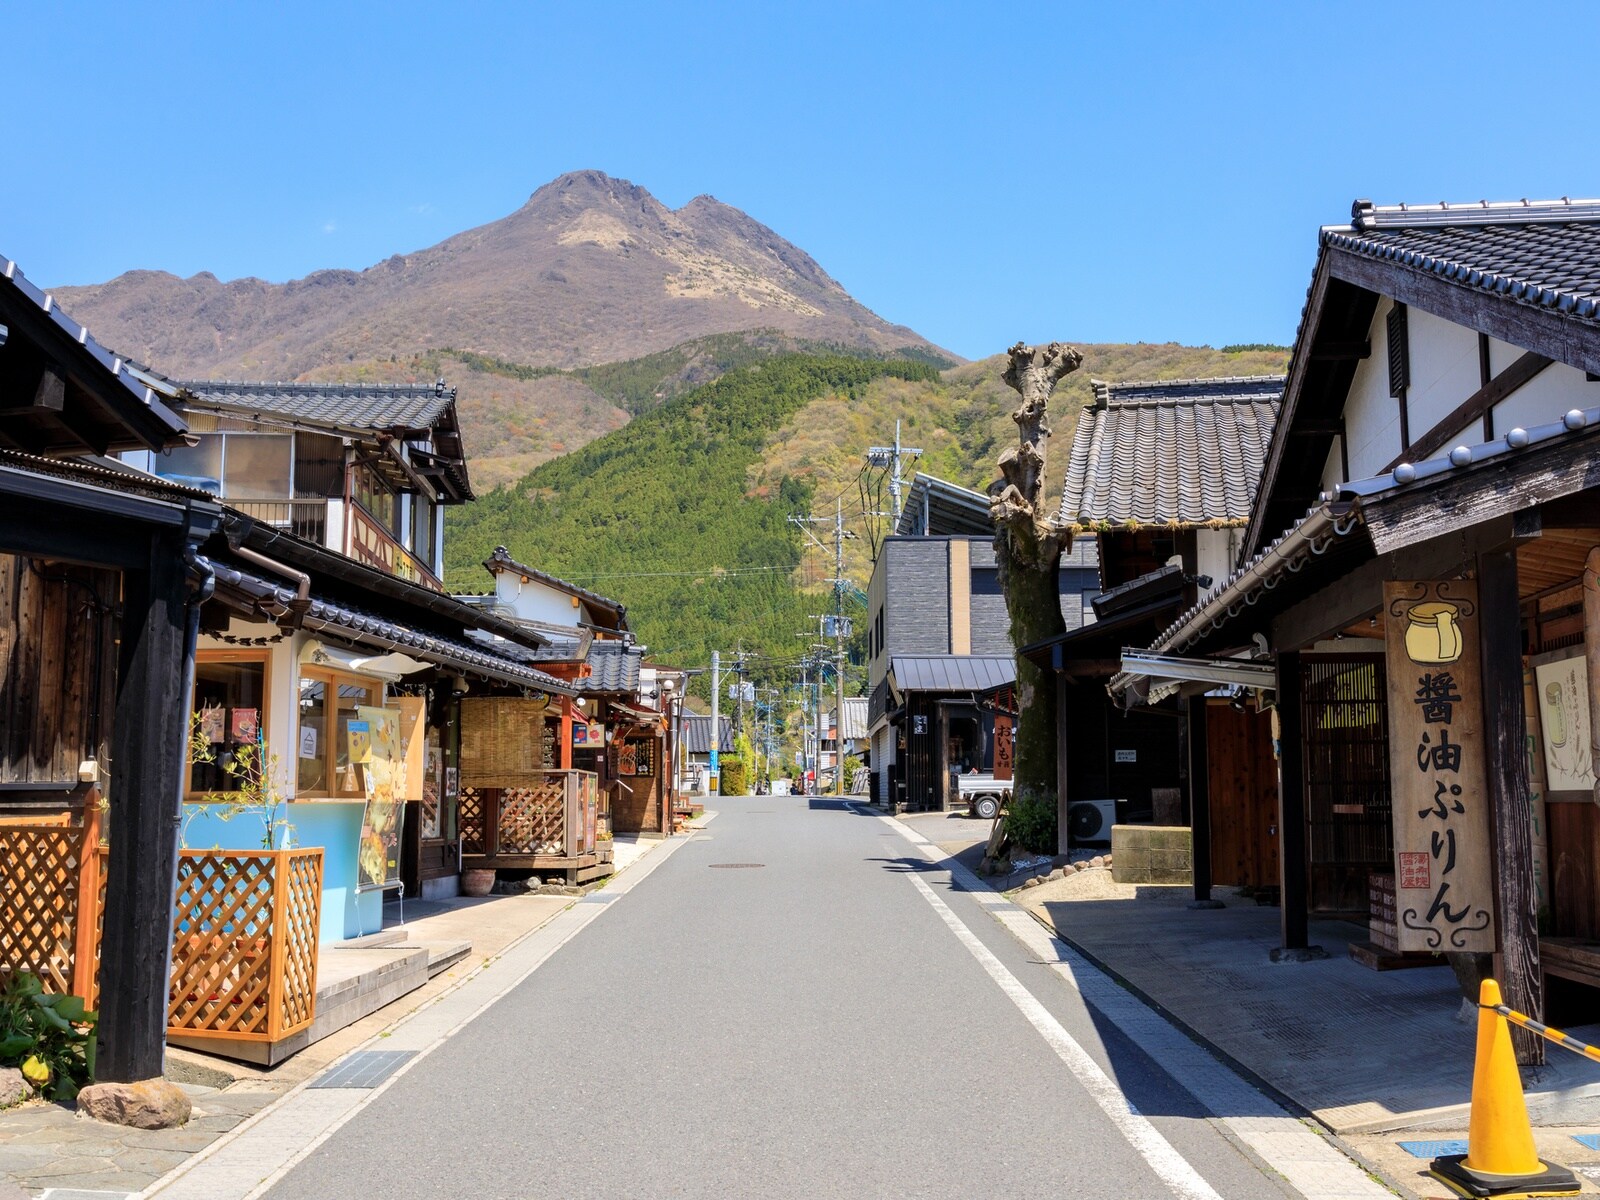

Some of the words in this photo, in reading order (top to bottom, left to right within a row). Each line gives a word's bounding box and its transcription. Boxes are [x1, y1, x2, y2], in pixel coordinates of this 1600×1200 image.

[997, 725, 1011, 760] おいも
[1414, 672, 1471, 923] 醤油ぷりん
